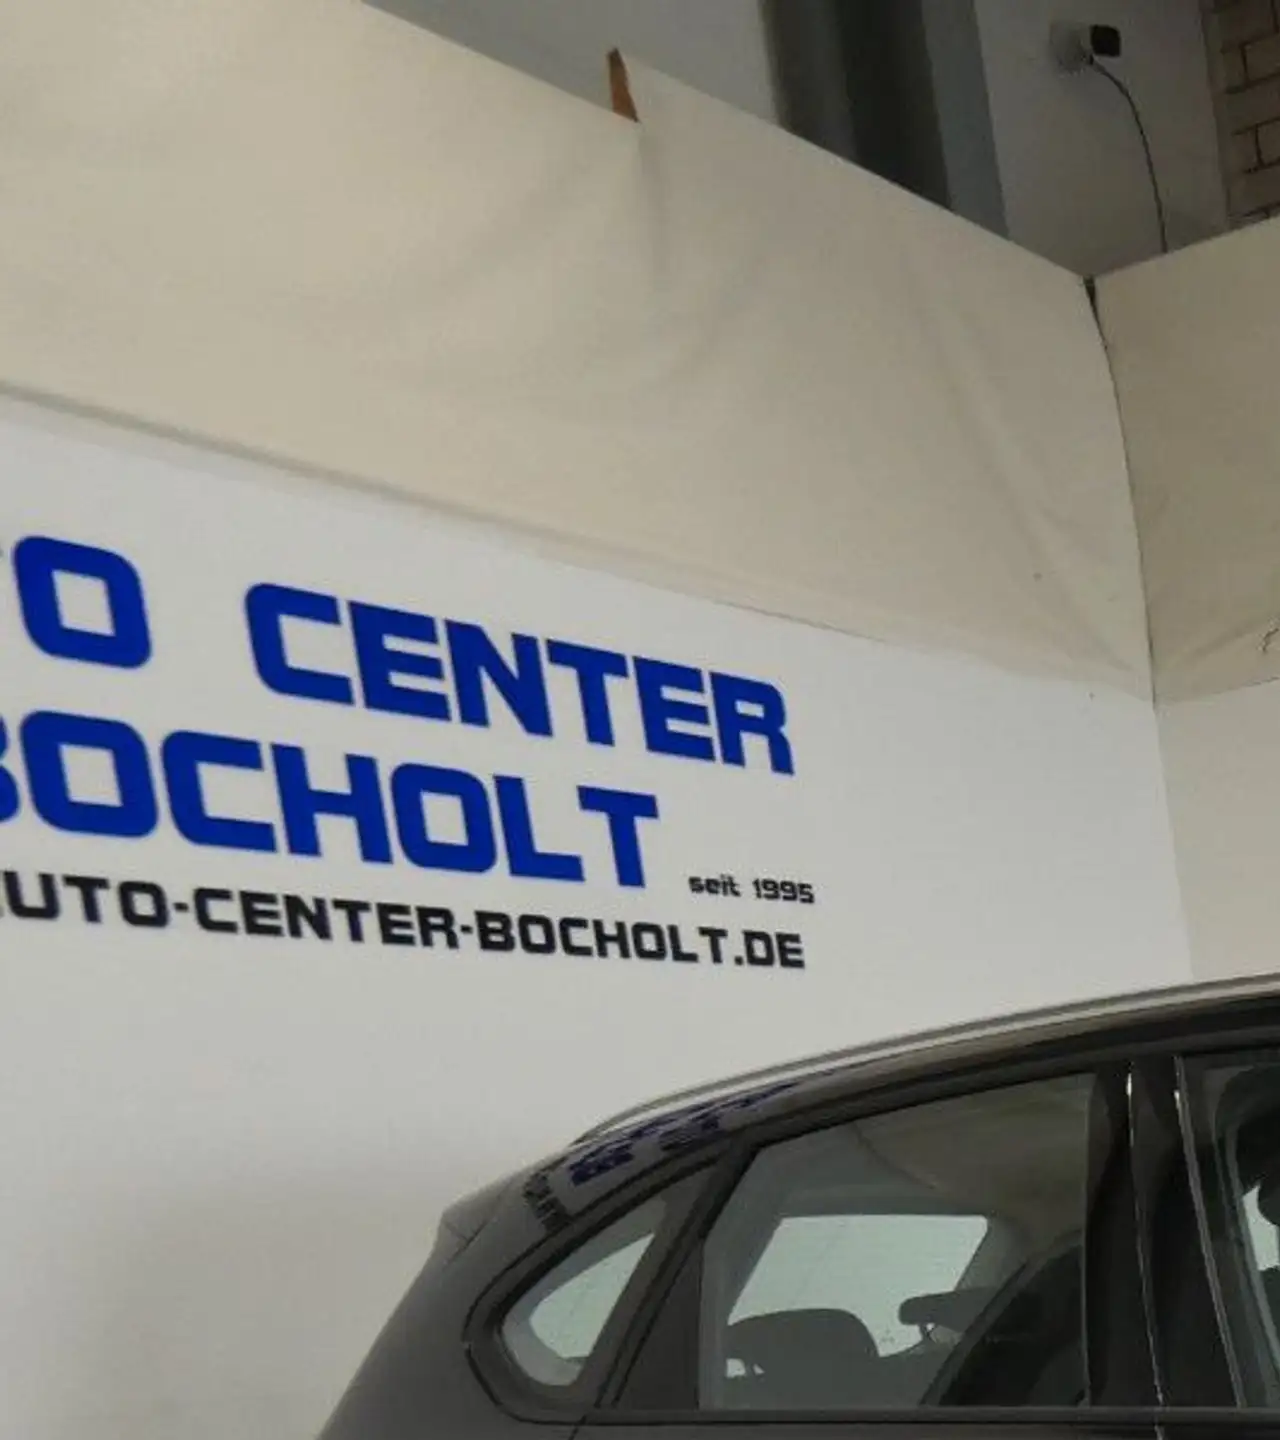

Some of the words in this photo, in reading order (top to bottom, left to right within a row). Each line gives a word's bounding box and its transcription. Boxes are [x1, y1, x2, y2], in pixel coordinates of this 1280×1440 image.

[244, 583, 795, 776] CENTER
[0, 710, 659, 888] OCHOLT
[0, 870, 806, 969] UTO-CENTER-BOCHOLT.DE
[687, 873, 742, 897] seit
[751, 878, 815, 904] 1995
